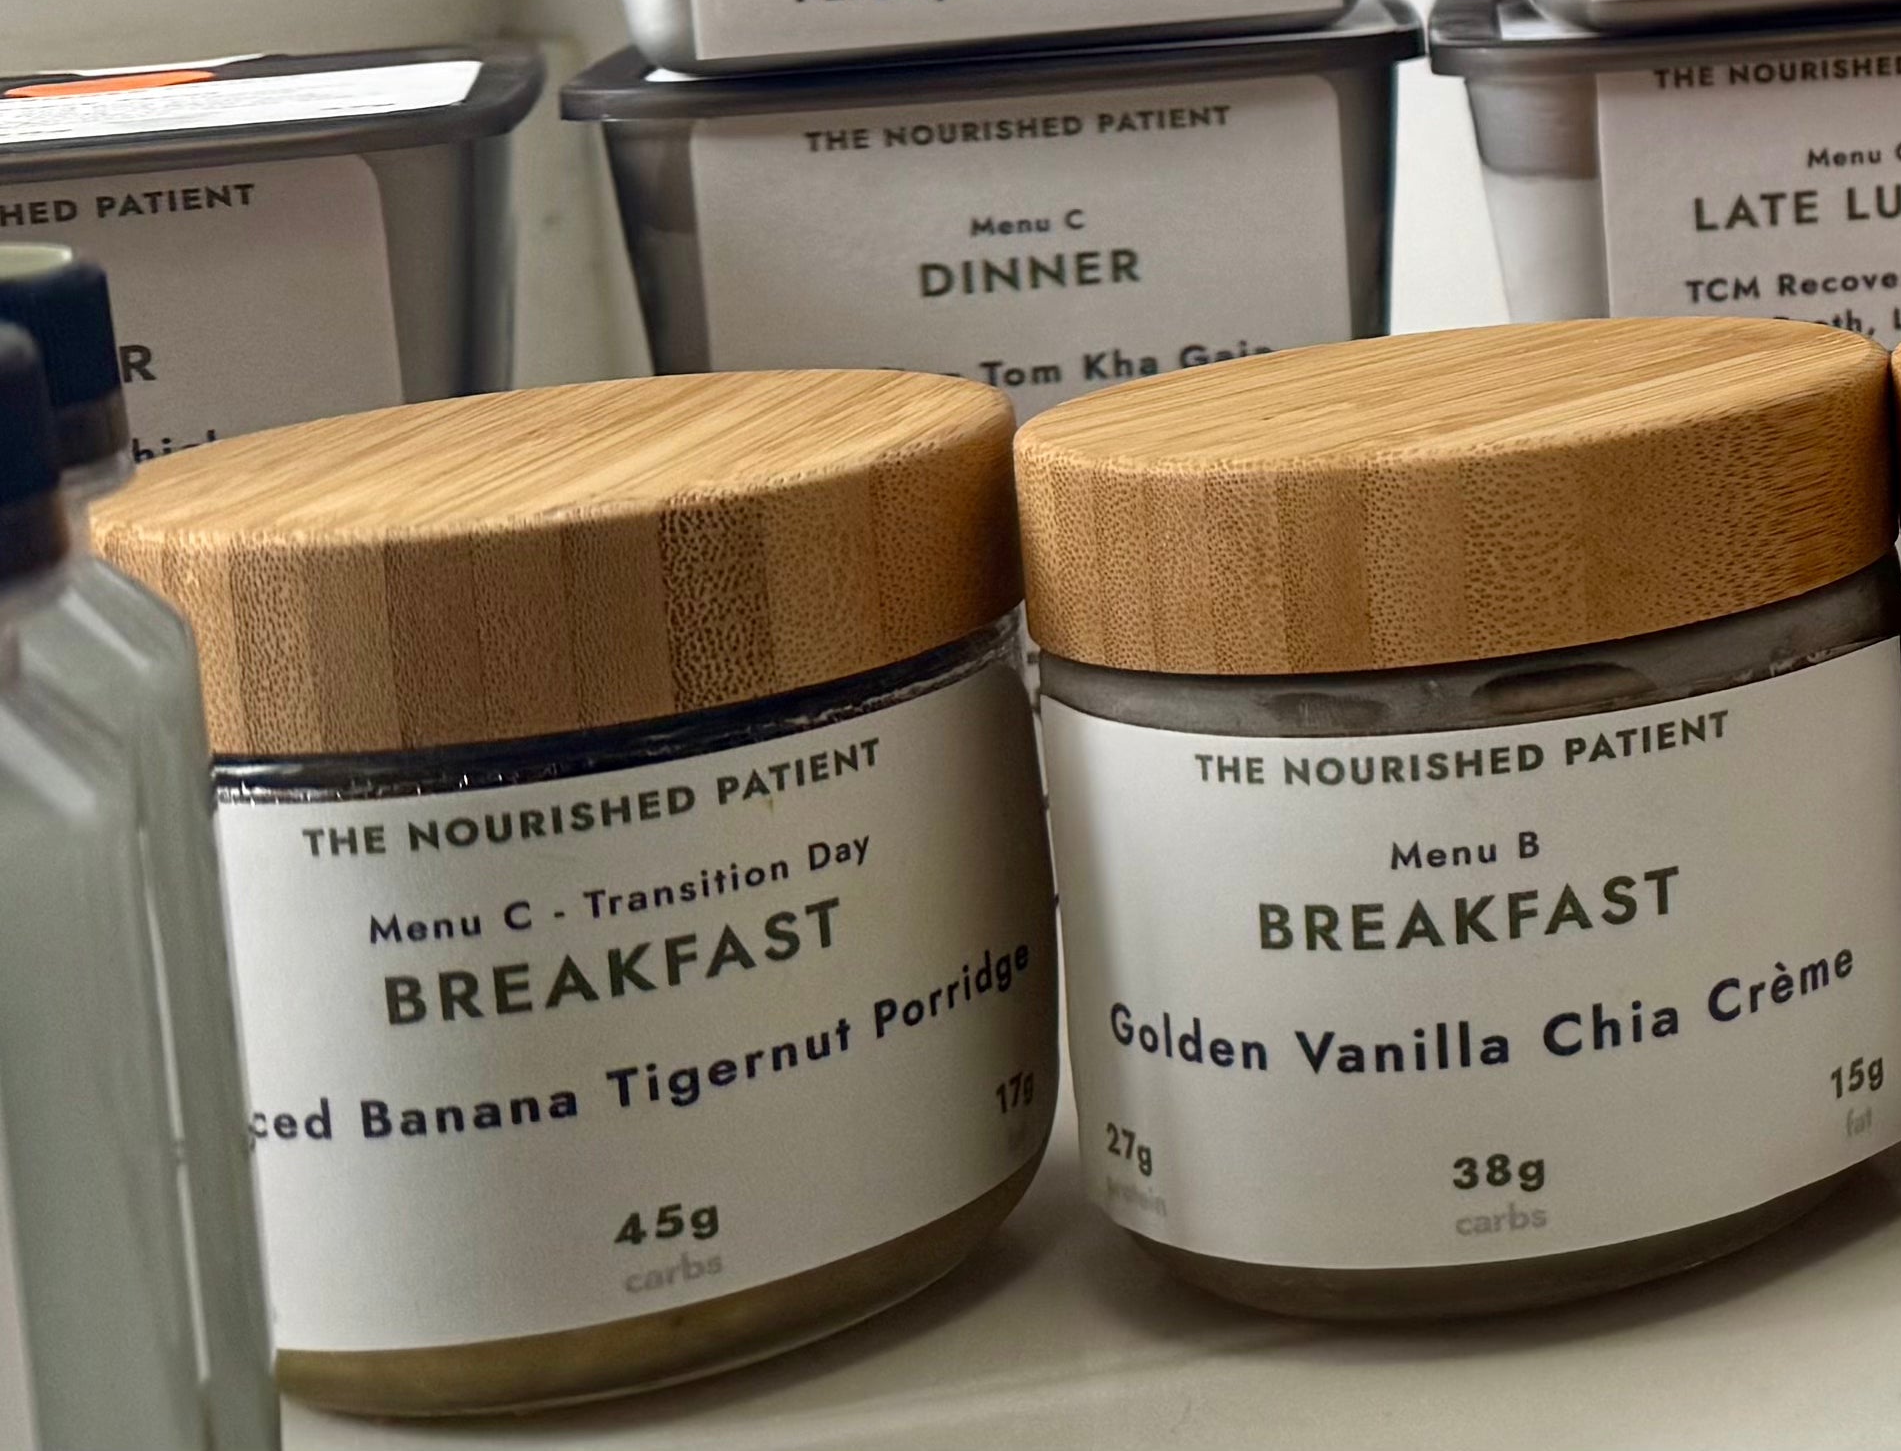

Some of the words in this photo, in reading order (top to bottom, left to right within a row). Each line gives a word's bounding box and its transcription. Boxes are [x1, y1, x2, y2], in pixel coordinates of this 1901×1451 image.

[1807, 149, 1881, 168] Menu
[96, 184, 254, 218] PATIENT
[1694, 190, 1818, 232] LATE
[970, 217, 1050, 236] Menu
[1064, 209, 1084, 230] C
[919, 249, 1140, 297] DINNER
[1685, 277, 1760, 303] TCM
[980, 360, 1061, 390] Tom
[1084, 349, 1164, 381] Kha
[302, 826, 386, 857] THE
[408, 785, 696, 852] NOURISHED
[718, 738, 881, 805] PATIENT
[1391, 841, 1496, 870] Menu
[1519, 831, 1539, 859] B
[370, 914, 481, 944] Menu
[504, 901, 531, 930] C
[583, 854, 789, 919] Transition
[808, 836, 869, 871] Day
[1259, 866, 1679, 951] BREAKFAST
[385, 898, 841, 1027] BREAKFAST
[1111, 1003, 1267, 1070] Golden
[1295, 1021, 1509, 1074] Vanilla
[1543, 1000, 1678, 1056] Chia
[1708, 949, 1852, 1022] Crème
[361, 1092, 577, 1139] Banana
[606, 1018, 850, 1107] Tigernut
[874, 946, 1027, 1039] Porridge
[1831, 1057, 1883, 1098] 15g
[1107, 1123, 1152, 1177] 27g
[1453, 1154, 1544, 1192] 38g
[614, 1204, 718, 1245] 45g
[1455, 1206, 1547, 1236] carbs
[624, 1254, 723, 1295] carbs
